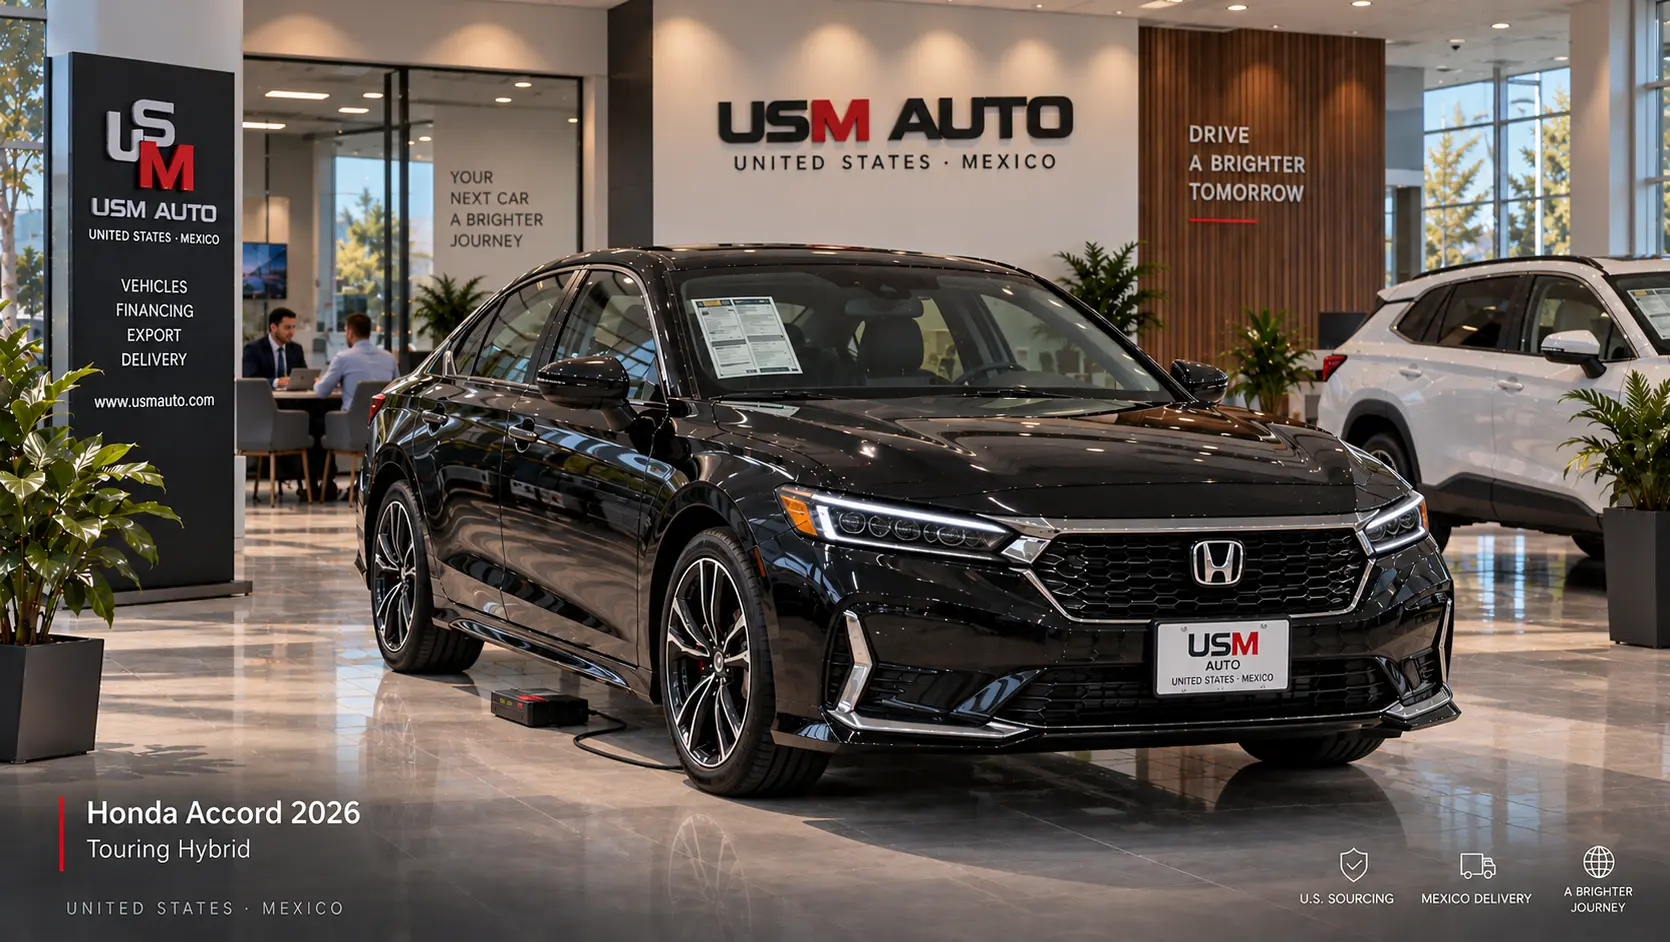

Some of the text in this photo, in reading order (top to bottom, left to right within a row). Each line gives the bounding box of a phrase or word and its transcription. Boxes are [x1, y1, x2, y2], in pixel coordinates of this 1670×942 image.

[718, 96, 1073, 143] USM AUTO
[1190, 125, 1249, 143] DRIVE
[735, 154, 1055, 171] UNITED STATES MEXICO
[1189, 155, 1305, 173] A BRIGHTER
[451, 171, 493, 184] YOUR
[451, 192, 528, 205] NEXT CAR
[1189, 183, 1304, 202] TOMORROW
[92, 198, 216, 222] USM AUTO
[451, 213, 543, 226] A BRIGHTER
[88, 229, 220, 245] UNITED STATES MEXICO
[451, 234, 523, 247] JOURNEY
[121, 279, 187, 293] VEHICLES
[117, 303, 193, 317] FINANCING
[128, 329, 181, 341] EXPORT
[122, 353, 187, 366] DELIVERY
[95, 394, 214, 408] www.usmauto.com
[1189, 632, 1258, 657] USM
[1206, 660, 1240, 670] AUTO
[1172, 673, 1273, 686] UNITED STATES MEXICO
